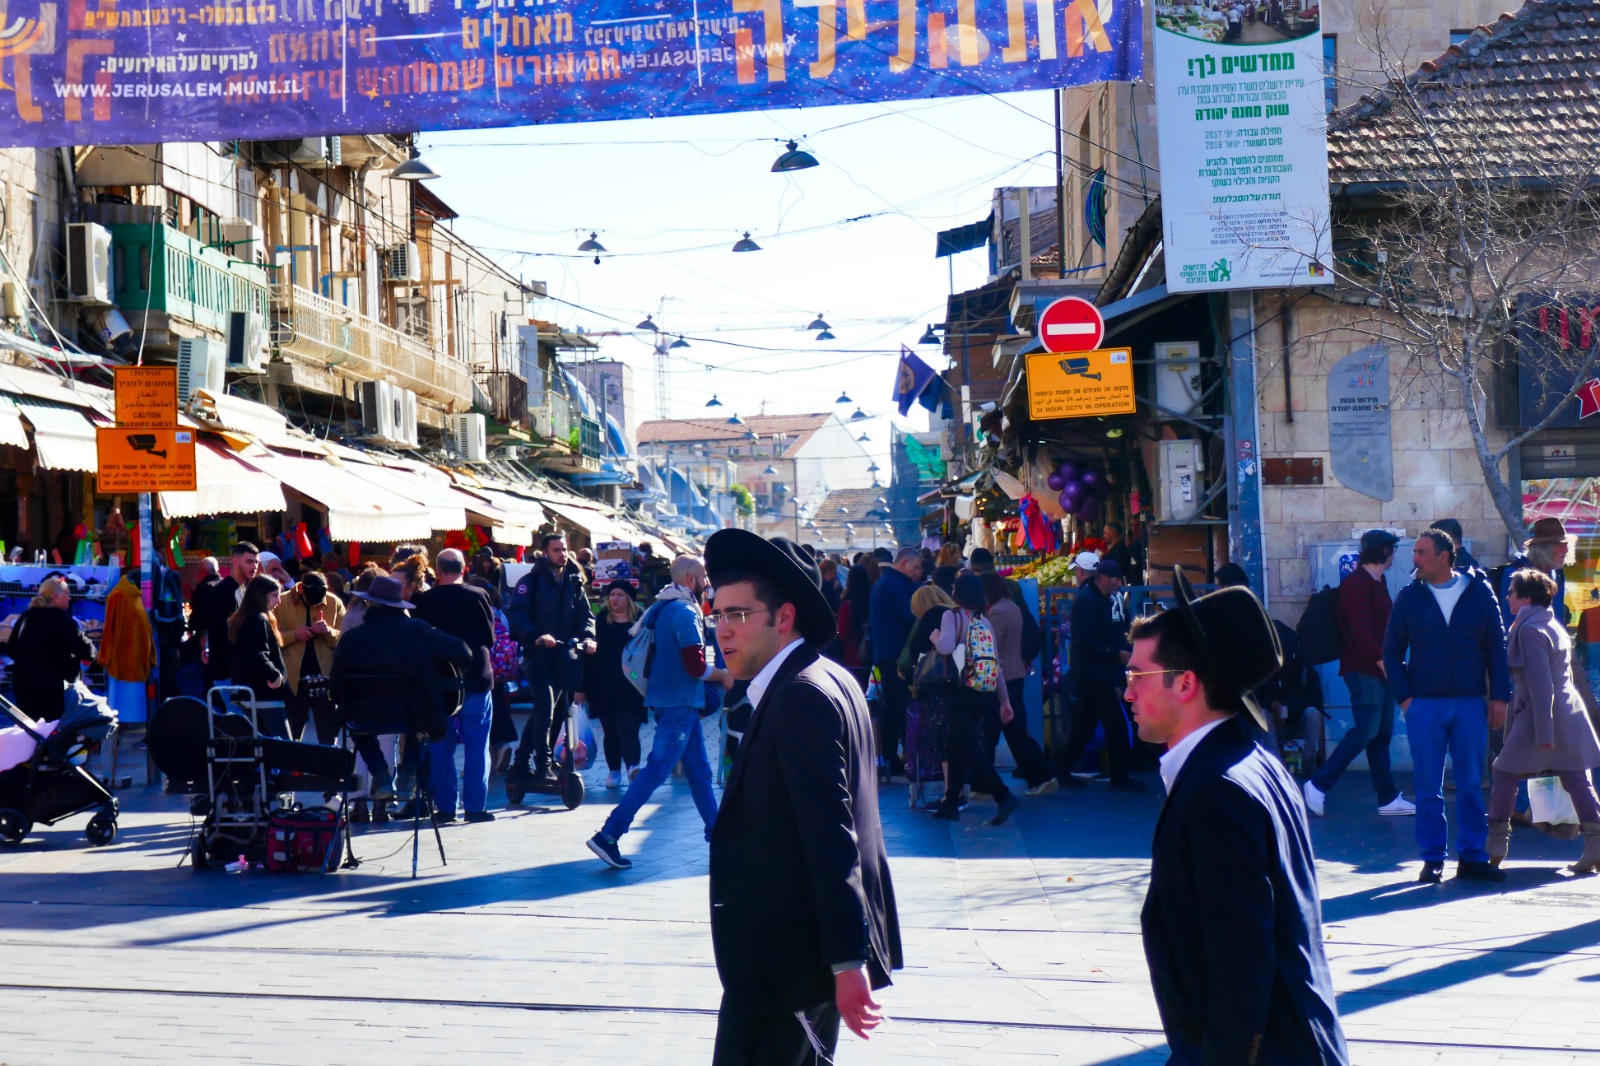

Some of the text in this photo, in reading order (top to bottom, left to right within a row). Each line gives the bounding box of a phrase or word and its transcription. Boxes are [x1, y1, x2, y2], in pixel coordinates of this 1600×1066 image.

[462, 11, 573, 49] מאחלים
[496, 51, 575, 88] אורים
[1187, 52, 1295, 79] מחדשים לך!
[54, 79, 303, 98] WWW.JERUSALEM.MUNI.IL
[1195, 103, 1289, 121] שוק מחנה יהודה
[1205, 130, 1222, 139] 2017
[1261, 126, 1282, 136] תחילת
[1205, 141, 1222, 150] 2018
[1268, 138, 1282, 146] סיום
[1258, 154, 1284, 164] מוזמנים
[1253, 164, 1262, 174] לא
[1261, 193, 1281, 201] תודה
[118, 380, 143, 388] לפניך
[1095, 401, 1130, 410] OPERATION
